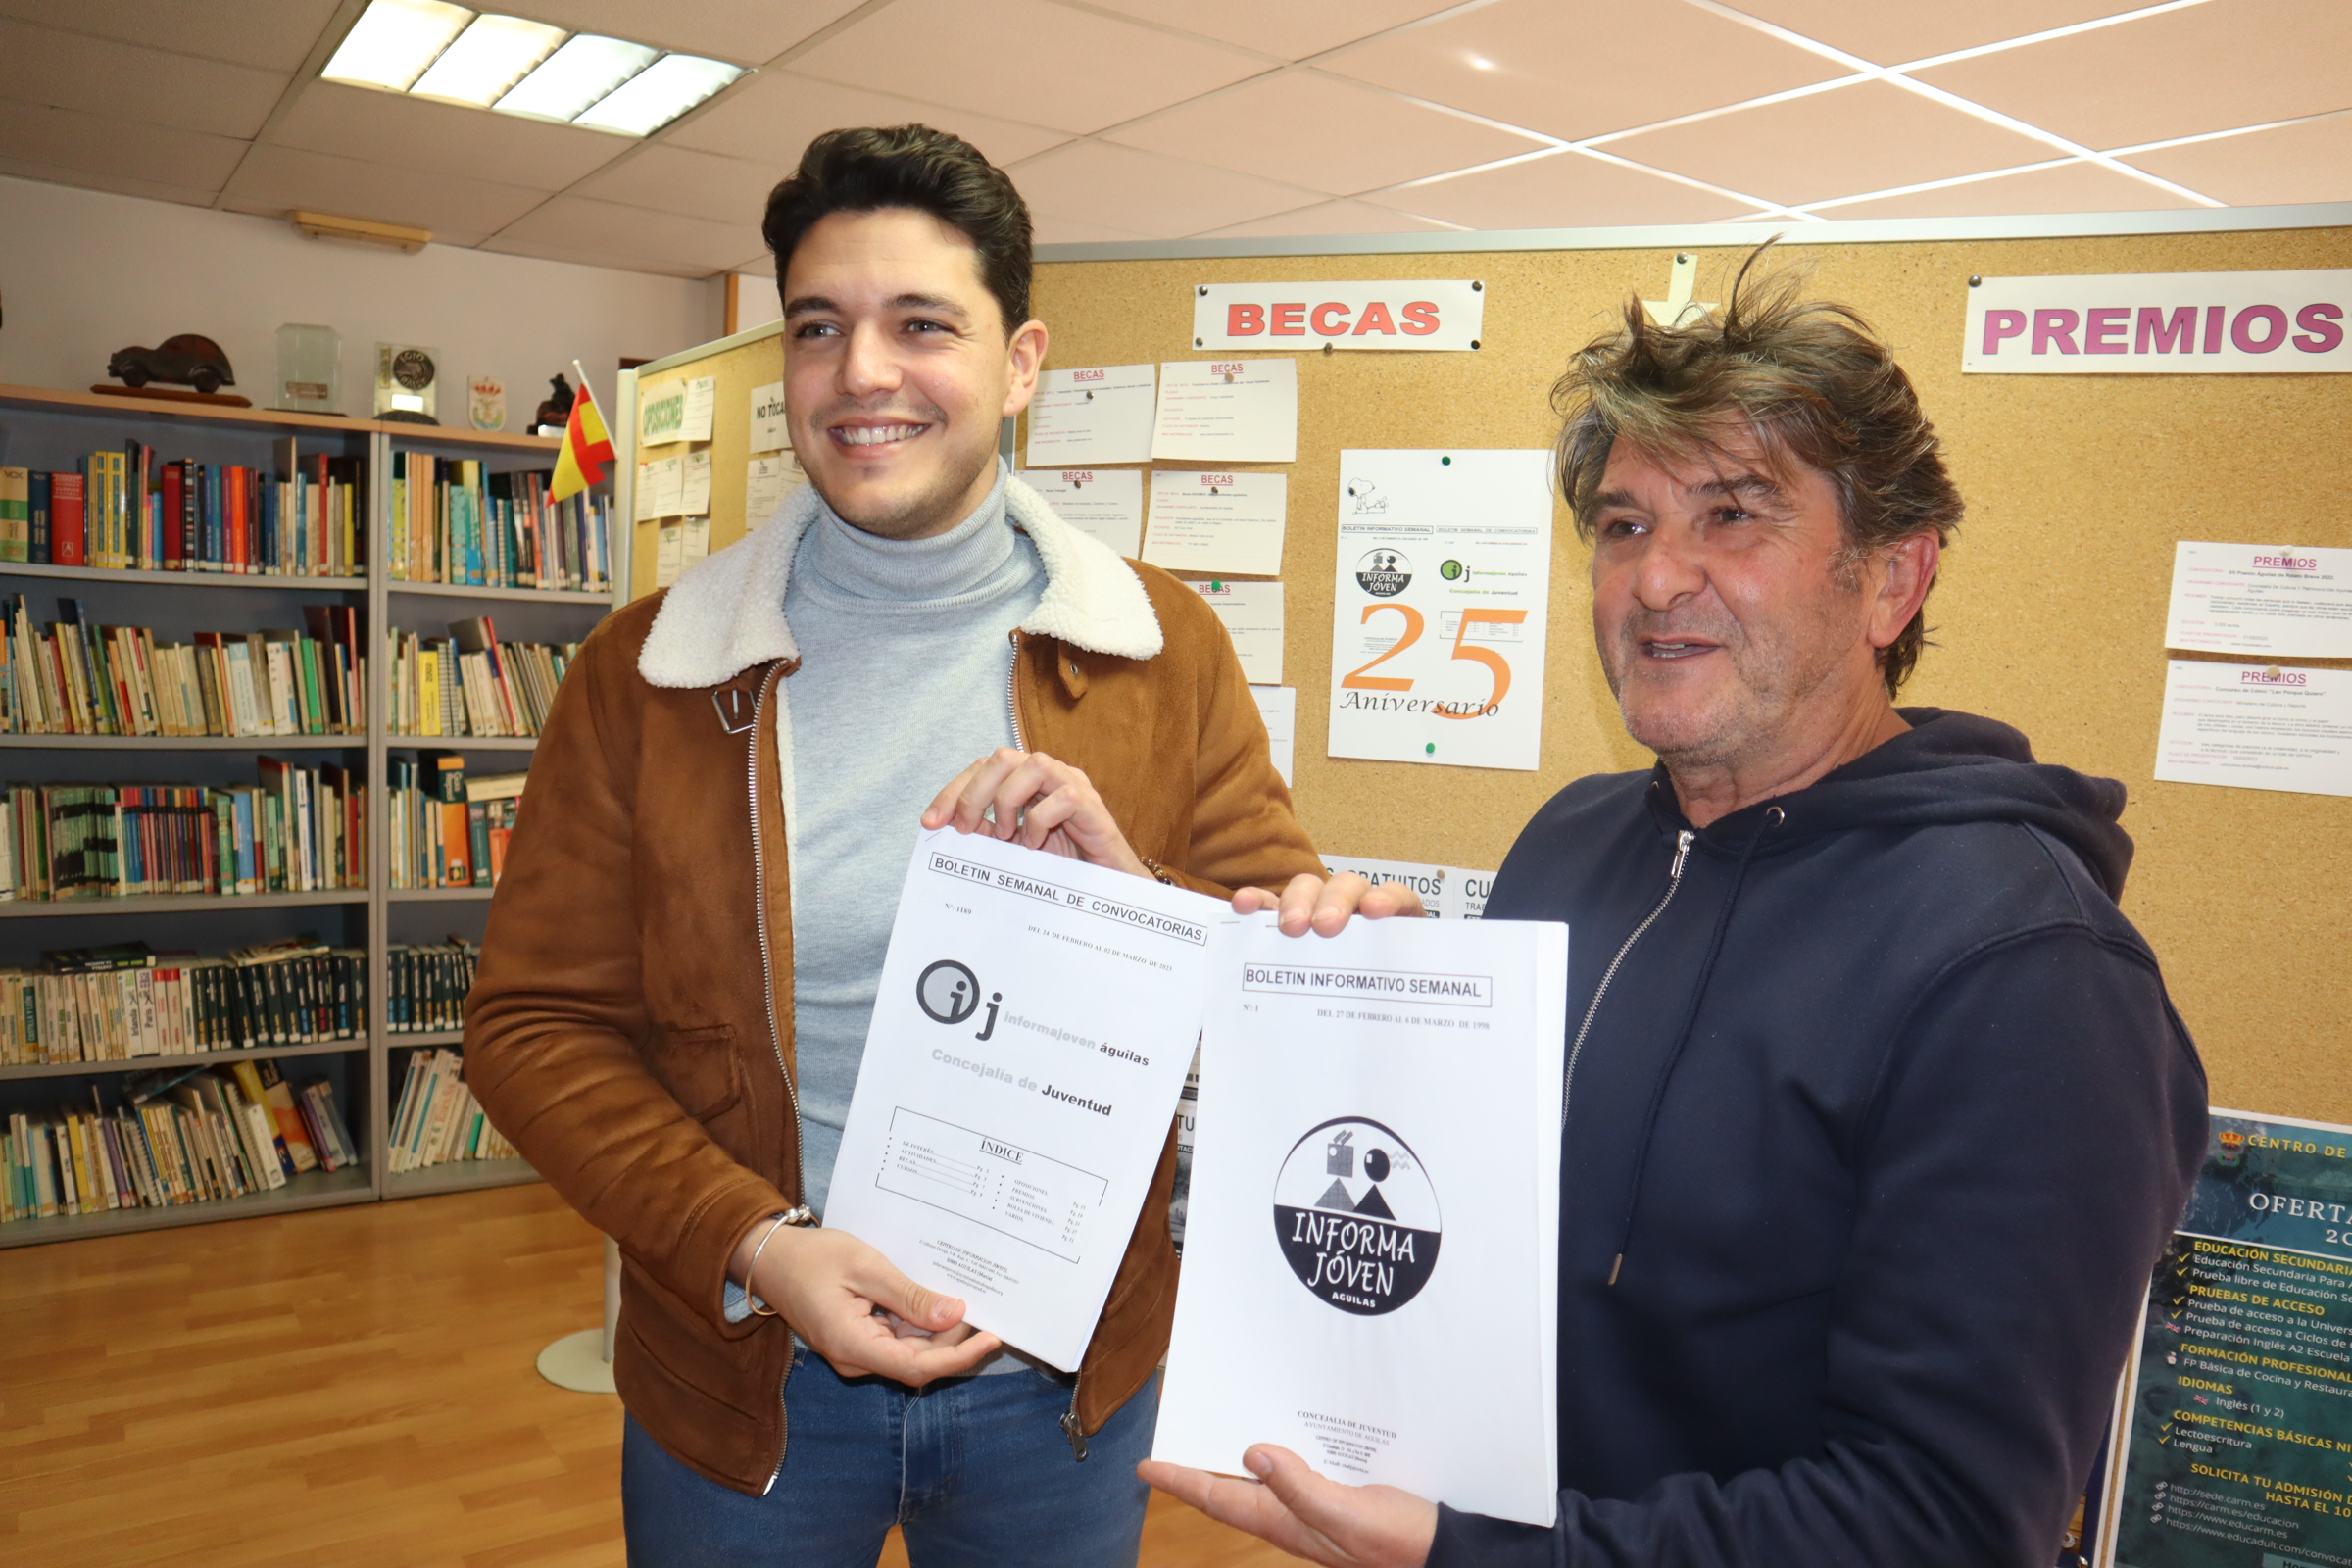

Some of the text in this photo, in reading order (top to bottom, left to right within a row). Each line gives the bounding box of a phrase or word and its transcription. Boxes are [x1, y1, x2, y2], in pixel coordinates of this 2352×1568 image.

[1227, 302, 1440, 336] BECAS
[1982, 303, 2344, 355] PREMIOS
[1074, 369, 1104, 380] BECAS
[1211, 364, 1244, 373] BECAS
[757, 406, 766, 419] NO
[4, 470, 24, 479] VOX
[1201, 475, 1234, 484] BECAS
[2254, 556, 2317, 568] PREMIOS
[1199, 584, 1231, 593] BEAS
[1362, 573, 1404, 583] INFORMA
[1367, 582, 1397, 593] JÓVEN
[1340, 603, 1529, 720] 25
[1339, 691, 1499, 717] Aniversario
[935, 858, 1203, 941] BOLETIN SEMANAL DE CONVOCATORIAS
[956, 906, 972, 915] 1189
[1027, 925, 1040, 934] DEL
[1061, 935, 1094, 949] FEBRERO
[1122, 953, 1147, 964] MARZO
[1246, 969, 1481, 997] BOLETIN INFORMATIVO SEMANAL
[27, 1015, 36, 1042] CASTILLA
[1346, 1010, 1355, 1019] DE
[1357, 1011, 1393, 1022] FEBRERO
[1405, 1016, 1411, 1025] 6
[1411, 1016, 1420, 1026] DE
[1424, 1017, 1455, 1027] MARZO
[1458, 1020, 1469, 1029] DE
[1473, 1021, 1490, 1030] 1998
[1004, 1011, 1150, 1067] informajoven águilas
[931, 1049, 1112, 1116] Concejalía de Juventud
[901, 1149, 936, 1163] ACTIVIDADES
[910, 1143, 934, 1154] INTERÉS
[980, 1137, 1023, 1163] ÍNDICE
[2247, 1133, 2346, 1158] CENTRO DE
[896, 1163, 917, 1174] CURSOS
[898, 1155, 916, 1165] BECAS
[1292, 1212, 1415, 1264] INFORMA
[2194, 1241, 2269, 1261] EDUCACIÓN
[1307, 1250, 1394, 1297] JÓVEN
[2192, 1268, 2232, 1283] Prueba
[2234, 1274, 2260, 1287] libre
[2262, 1280, 2277, 1290] de
[2279, 1282, 2338, 1300] Educación
[2194, 1254, 2250, 1272] Educación
[2252, 1263, 2316, 1283] Secundaria
[2319, 1274, 2345, 1288] Para
[1331, 1292, 1376, 1308] AGUILAS
[2188, 1298, 2228, 1313] Prueba
[2230, 1305, 2244, 1316] de
[2246, 1309, 2284, 1323] acceso
[2297, 1316, 2308, 1327] la
[2189, 1284, 2325, 1316] PRUEBAS DE ACCESO
[2186, 1311, 2347, 1348] Prueba de acceso a Ciclos de
[2184, 1325, 2350, 1363] Preparación Inglés A2 Escuela
[2180, 1343, 2352, 1383] FORMACIÓN PROFESIONAL
[2183, 1357, 2197, 1367] FP
[2199, 1360, 2234, 1375] Básica
[2236, 1368, 2252, 1378] de
[2253, 1370, 2292, 1386] Cocina
[2293, 1380, 2302, 1390] y
[2178, 1375, 2233, 1395] IDIOMAS
[2216, 1396, 2285, 1419] Inglés (1 y 2)
[1298, 1410, 1347, 1426] CONCEJALIA
[1358, 1422, 1396, 1439] JUVENTUD
[1304, 1421, 1354, 1437] AYUNTAMIENTO
[1364, 1434, 1390, 1446] AGUILAS
[2174, 1410, 2273, 1438] COMPETENCIAS
[2277, 1429, 2332, 1449] BÁSICAS
[2175, 1426, 2253, 1449] Lectoescritura
[2173, 1439, 2213, 1453] Lengua
[2190, 1463, 2249, 1484] SOLICITA
[2253, 1475, 2272, 1488] TU
[2274, 1481, 2343, 1503] ADMISIÓN
[2170, 1484, 2266, 1511] http://sede.carm.es
[2265, 1491, 2352, 1518] HASTA EL 10
[2167, 1504, 2288, 1539] https://www.educarm.es
[2170, 1494, 2299, 1529] https://carm.es/educacion
